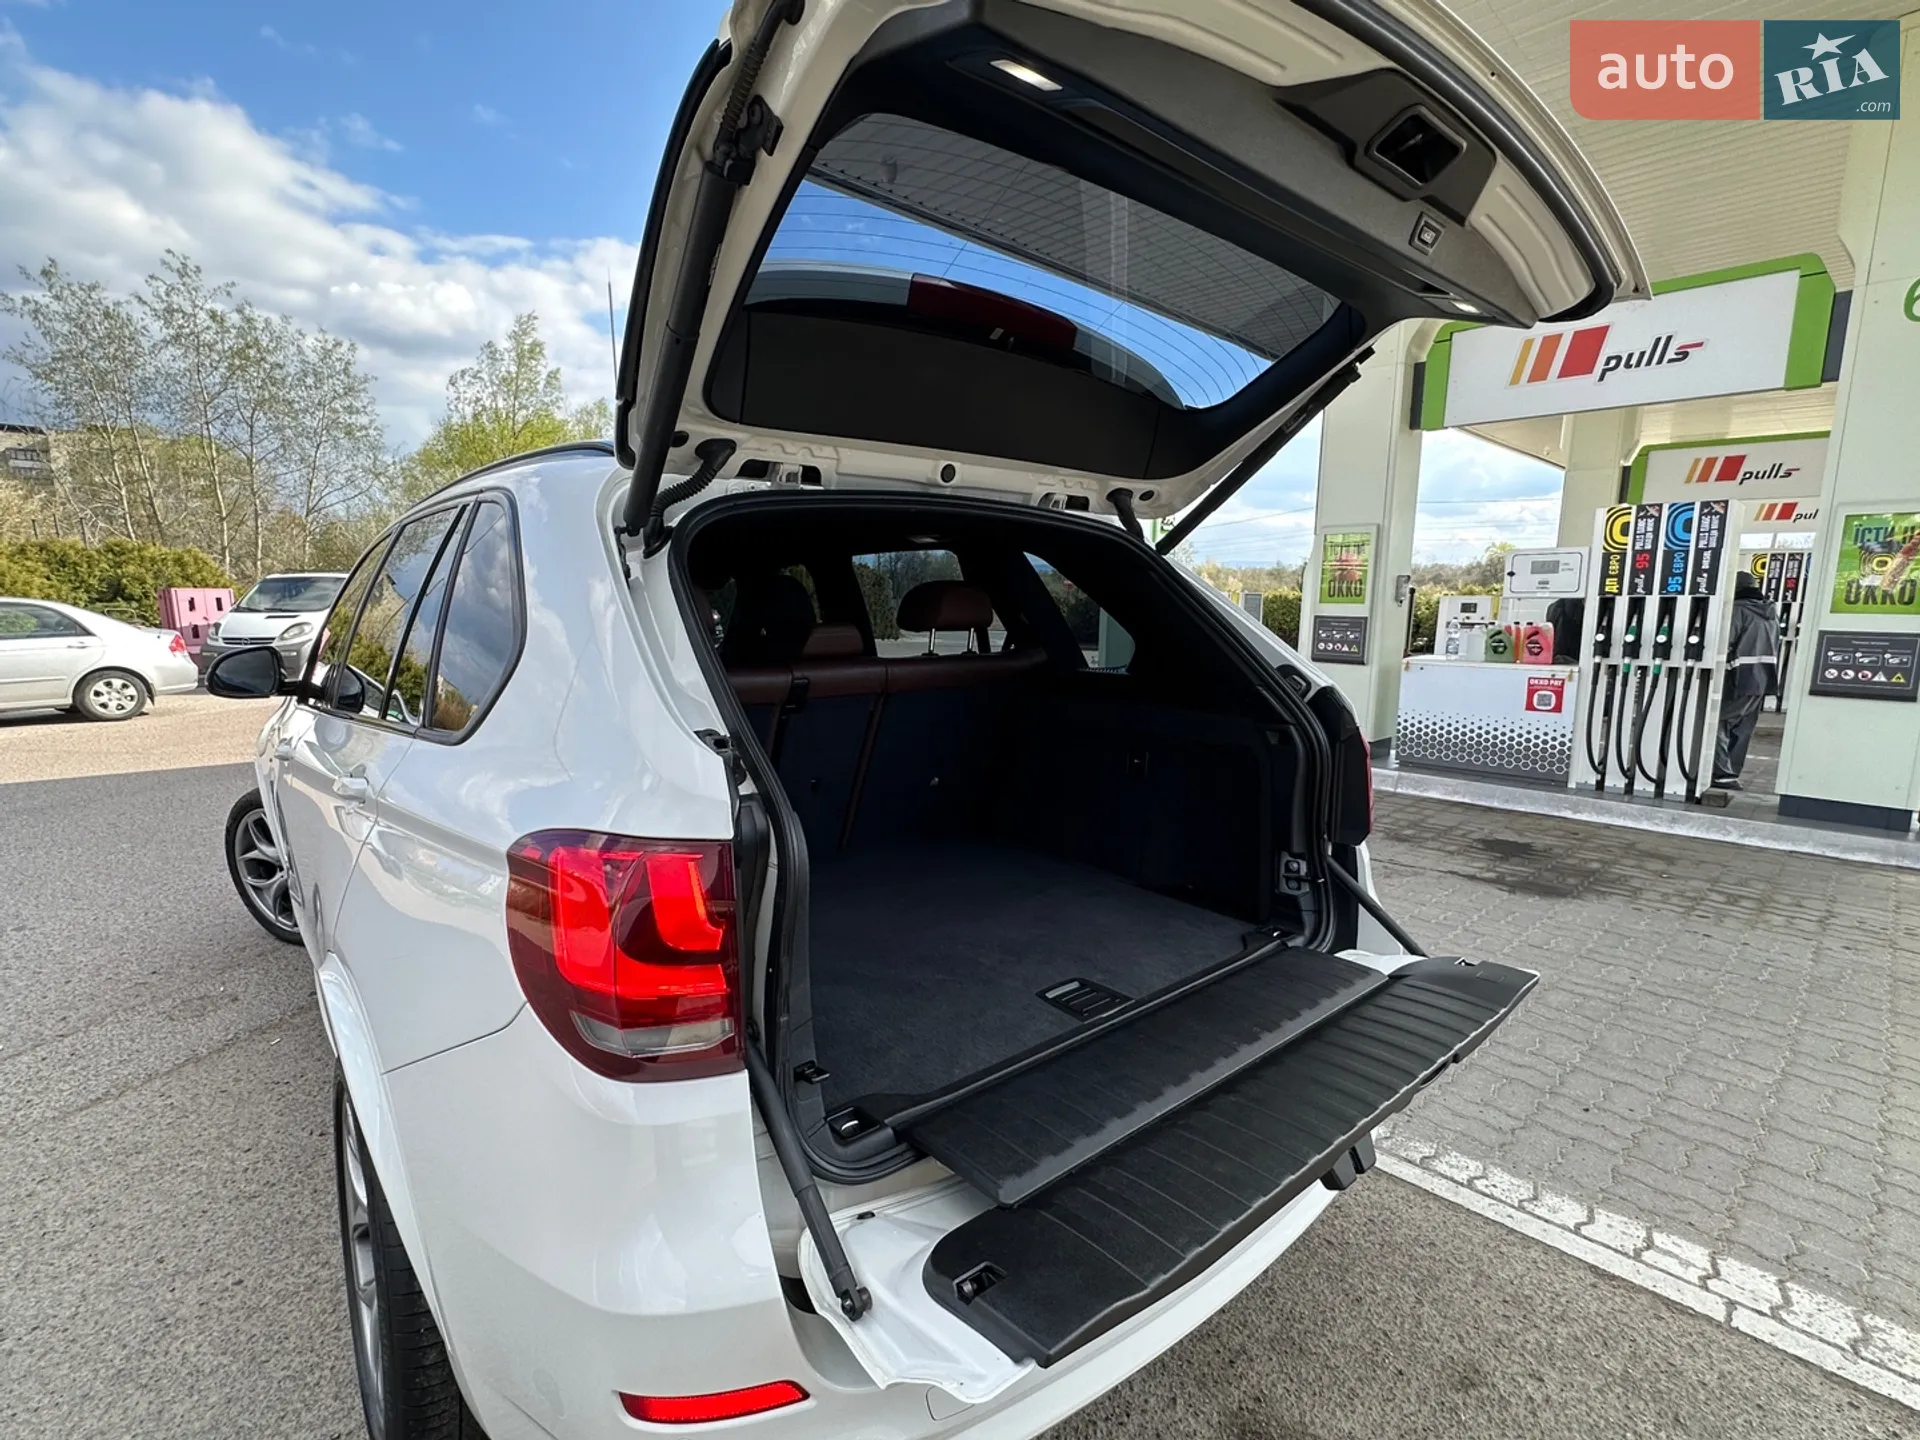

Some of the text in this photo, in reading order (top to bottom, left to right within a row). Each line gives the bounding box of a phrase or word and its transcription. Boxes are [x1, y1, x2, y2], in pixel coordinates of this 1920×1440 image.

[1598, 334, 1704, 382] pulls
[1739, 463, 1800, 485] pulls
[1635, 553, 1650, 569] 95
